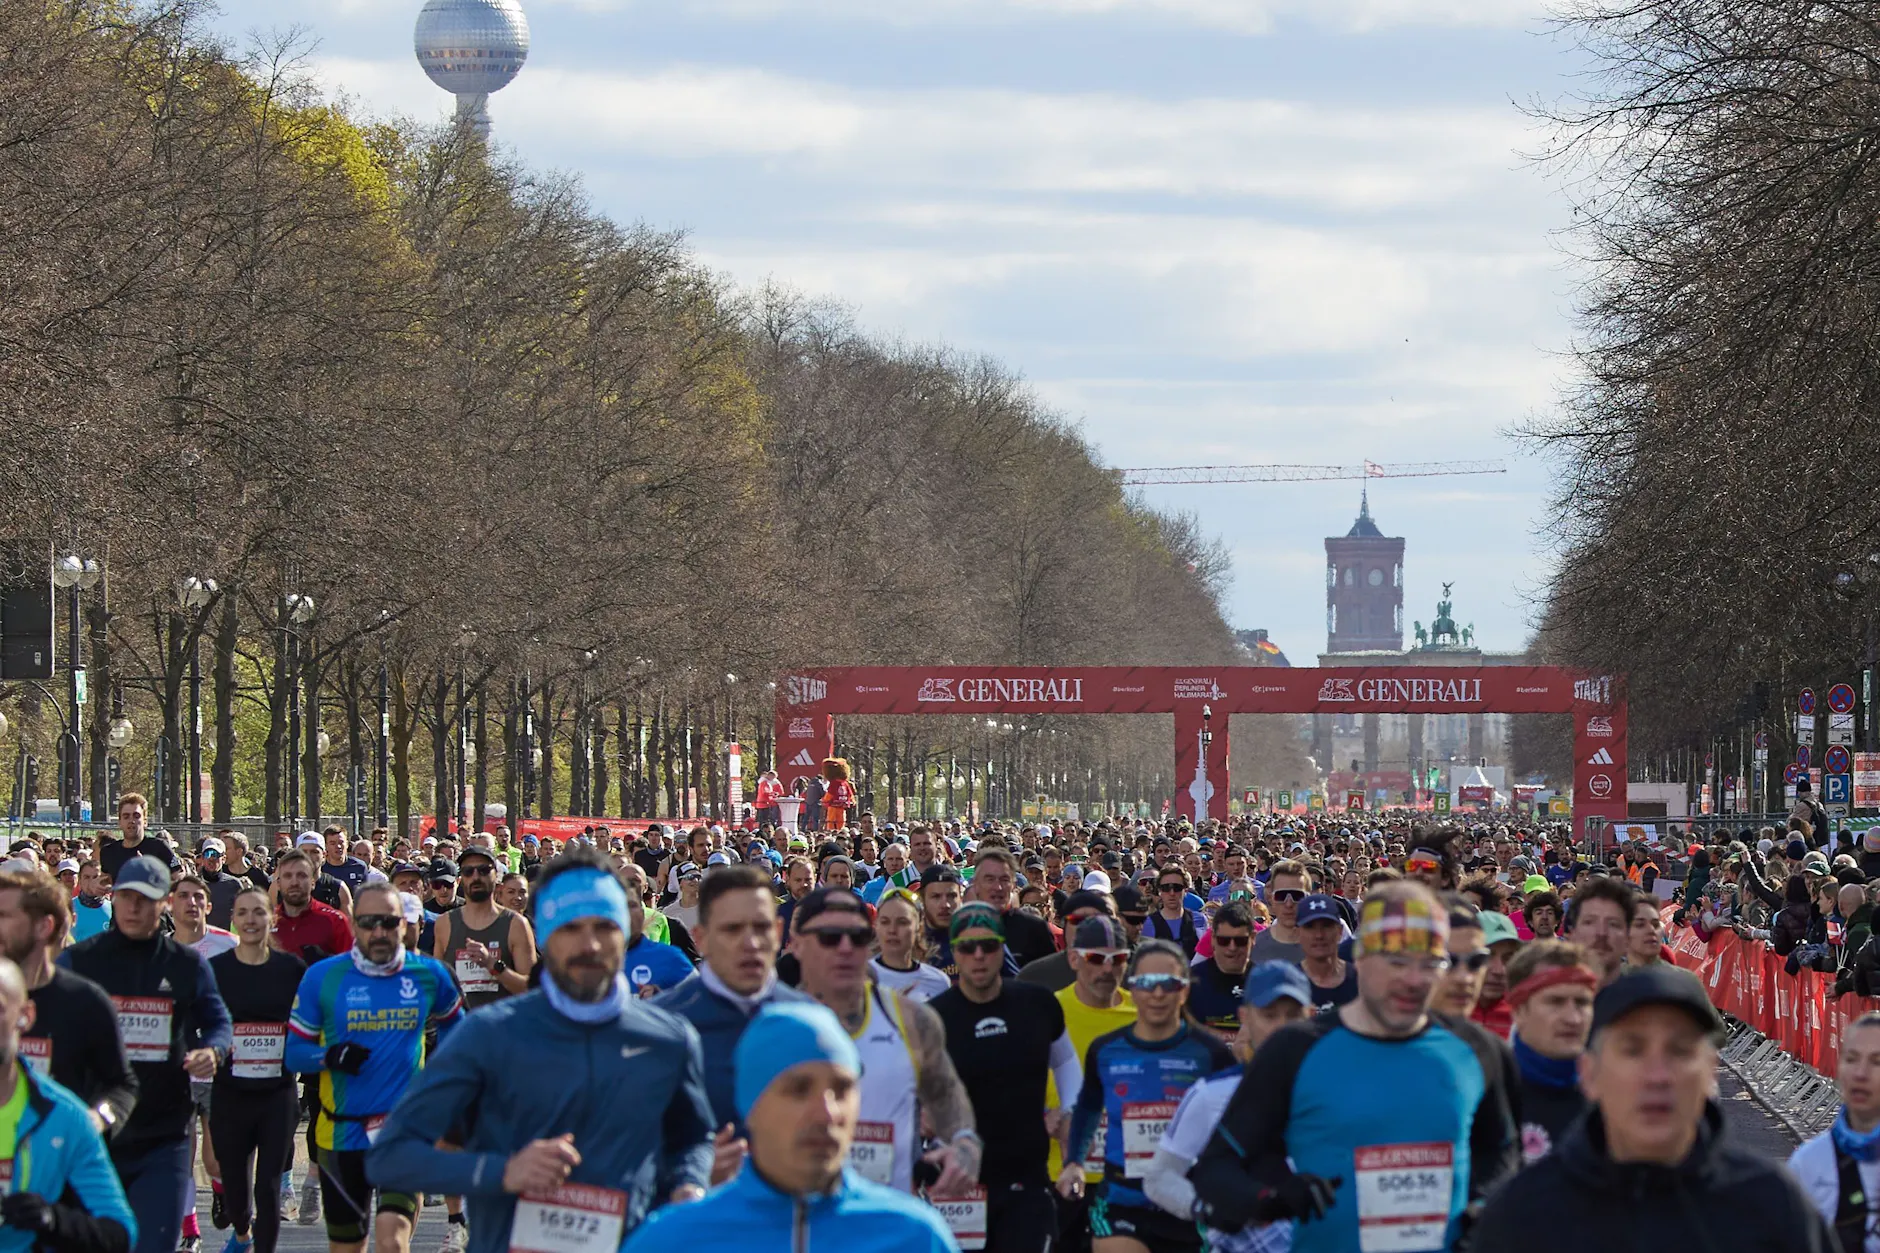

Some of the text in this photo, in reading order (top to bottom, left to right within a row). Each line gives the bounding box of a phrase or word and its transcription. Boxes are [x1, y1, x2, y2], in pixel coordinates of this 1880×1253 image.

[788, 675, 827, 705] START
[958, 678, 1083, 702] GENERALI
[1357, 678, 1482, 702] GENERALI
[1828, 778, 1842, 800] P
[1246, 792, 1256, 803] A
[1281, 794, 1288, 805] B
[1351, 797, 1361, 808] A
[1438, 798, 1446, 810] B
[1552, 801, 1561, 811] C
[123, 1001, 169, 1012] GENERALI
[347, 1008, 419, 1020] ATLETICA
[246, 1026, 282, 1034] GENERALI
[347, 1020, 418, 1032] PARATICO
[243, 1038, 276, 1047] 60538
[1382, 1147, 1449, 1166] GENERALI
[540, 1208, 601, 1234] 16972
